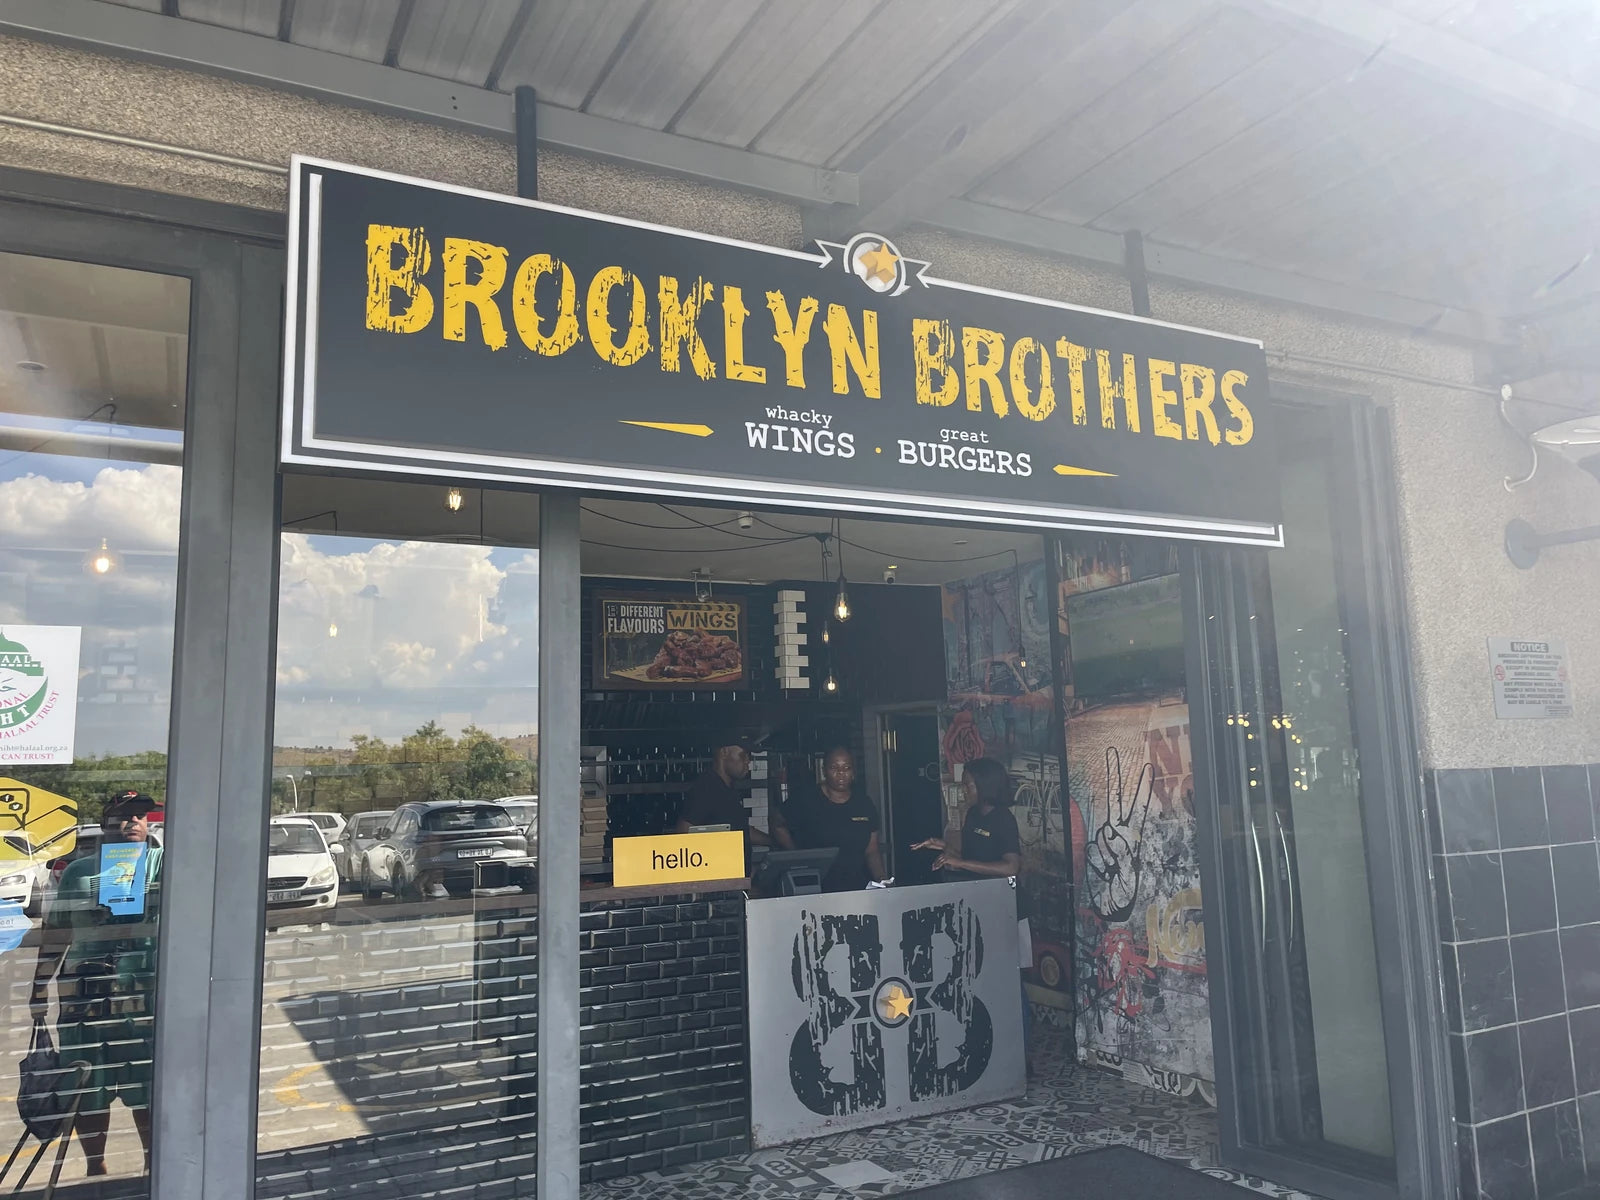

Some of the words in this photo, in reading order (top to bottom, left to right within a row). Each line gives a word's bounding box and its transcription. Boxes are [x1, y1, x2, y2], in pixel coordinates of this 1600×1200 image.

[365, 223, 881, 399] BROOKLYN
[912, 318, 1254, 447] BROTHERS
[765, 405, 833, 428] whacky
[940, 427, 989, 443] great
[745, 421, 855, 458] WINGS
[898, 439, 1033, 477] BURGERS
[620, 605, 664, 618] DIFFERENT
[668, 611, 736, 628] WINGS
[608, 618, 665, 634] FLAVOURS
[1513, 642, 1547, 652] NOTICE
[37, 690, 60, 719] TRUST
[652, 847, 709, 870] hello.
